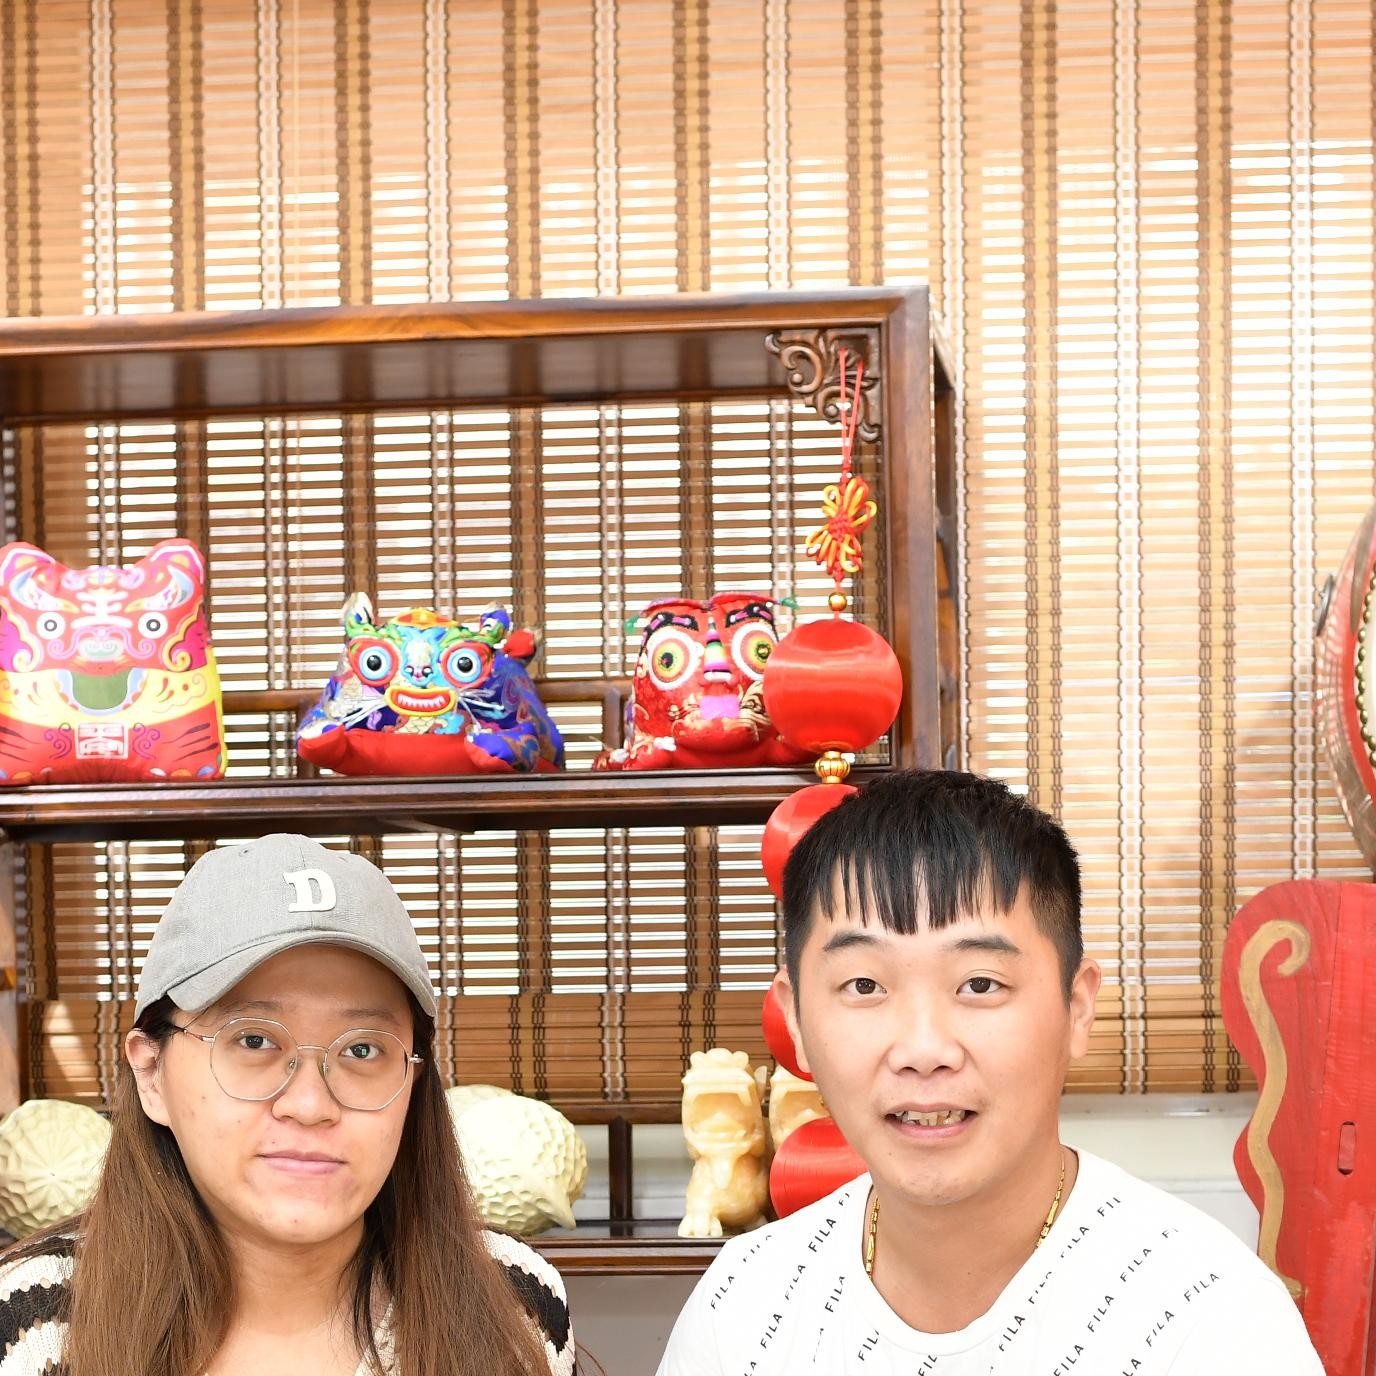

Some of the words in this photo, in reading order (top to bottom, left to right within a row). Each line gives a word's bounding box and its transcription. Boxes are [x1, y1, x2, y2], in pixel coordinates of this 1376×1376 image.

[283, 869, 336, 912] D
[711, 1276, 734, 1309] FILA
[760, 1314, 782, 1349] FILA
[808, 1219, 836, 1252] FILA
[825, 1276, 845, 1312] FILA
[1088, 1296, 1114, 1332] FILA
[1120, 1249, 1151, 1282] FILA
[1146, 1311, 1174, 1347] FILA
[1184, 1274, 1219, 1302] FILA
